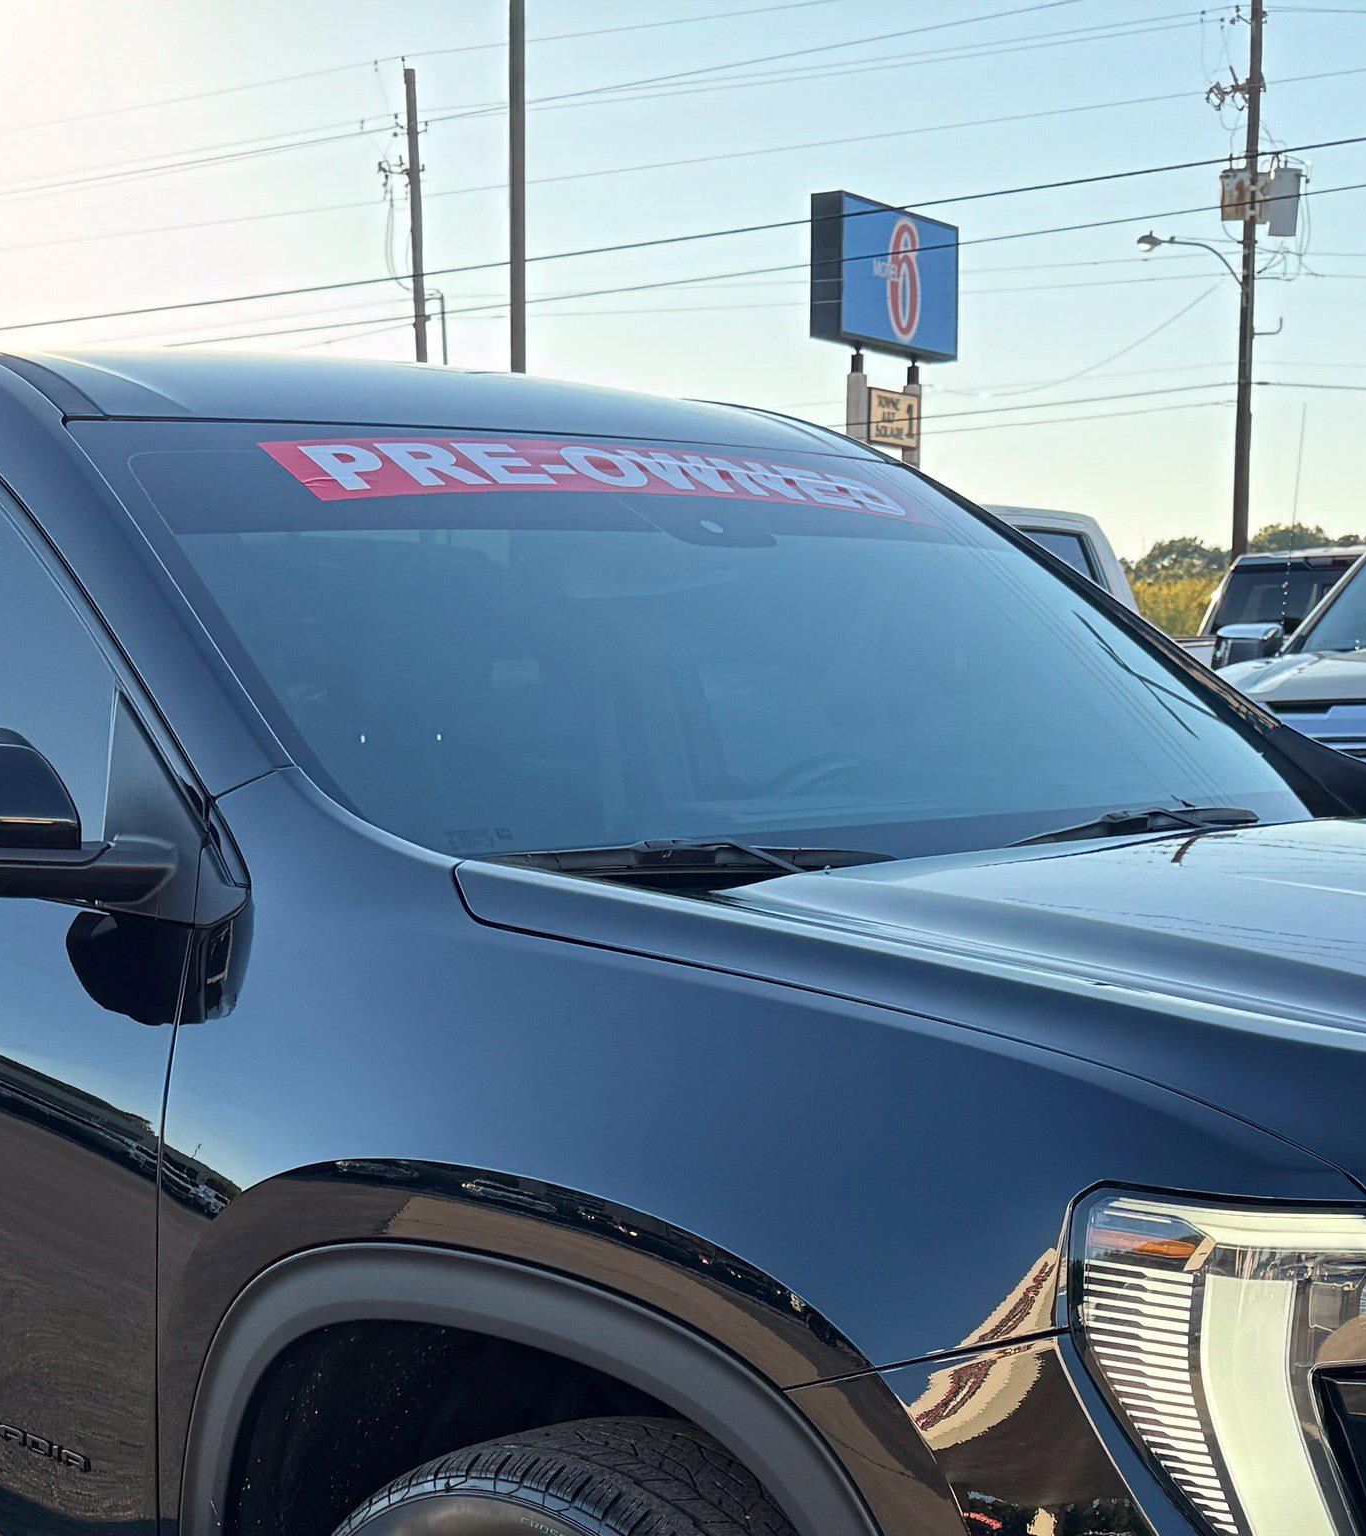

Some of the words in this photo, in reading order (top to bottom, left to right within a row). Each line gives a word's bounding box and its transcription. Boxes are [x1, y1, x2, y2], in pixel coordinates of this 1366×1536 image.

[873, 257, 903, 283] MOTEL
[887, 217, 921, 343] 6
[297, 442, 907, 517] PRE-OWNED
